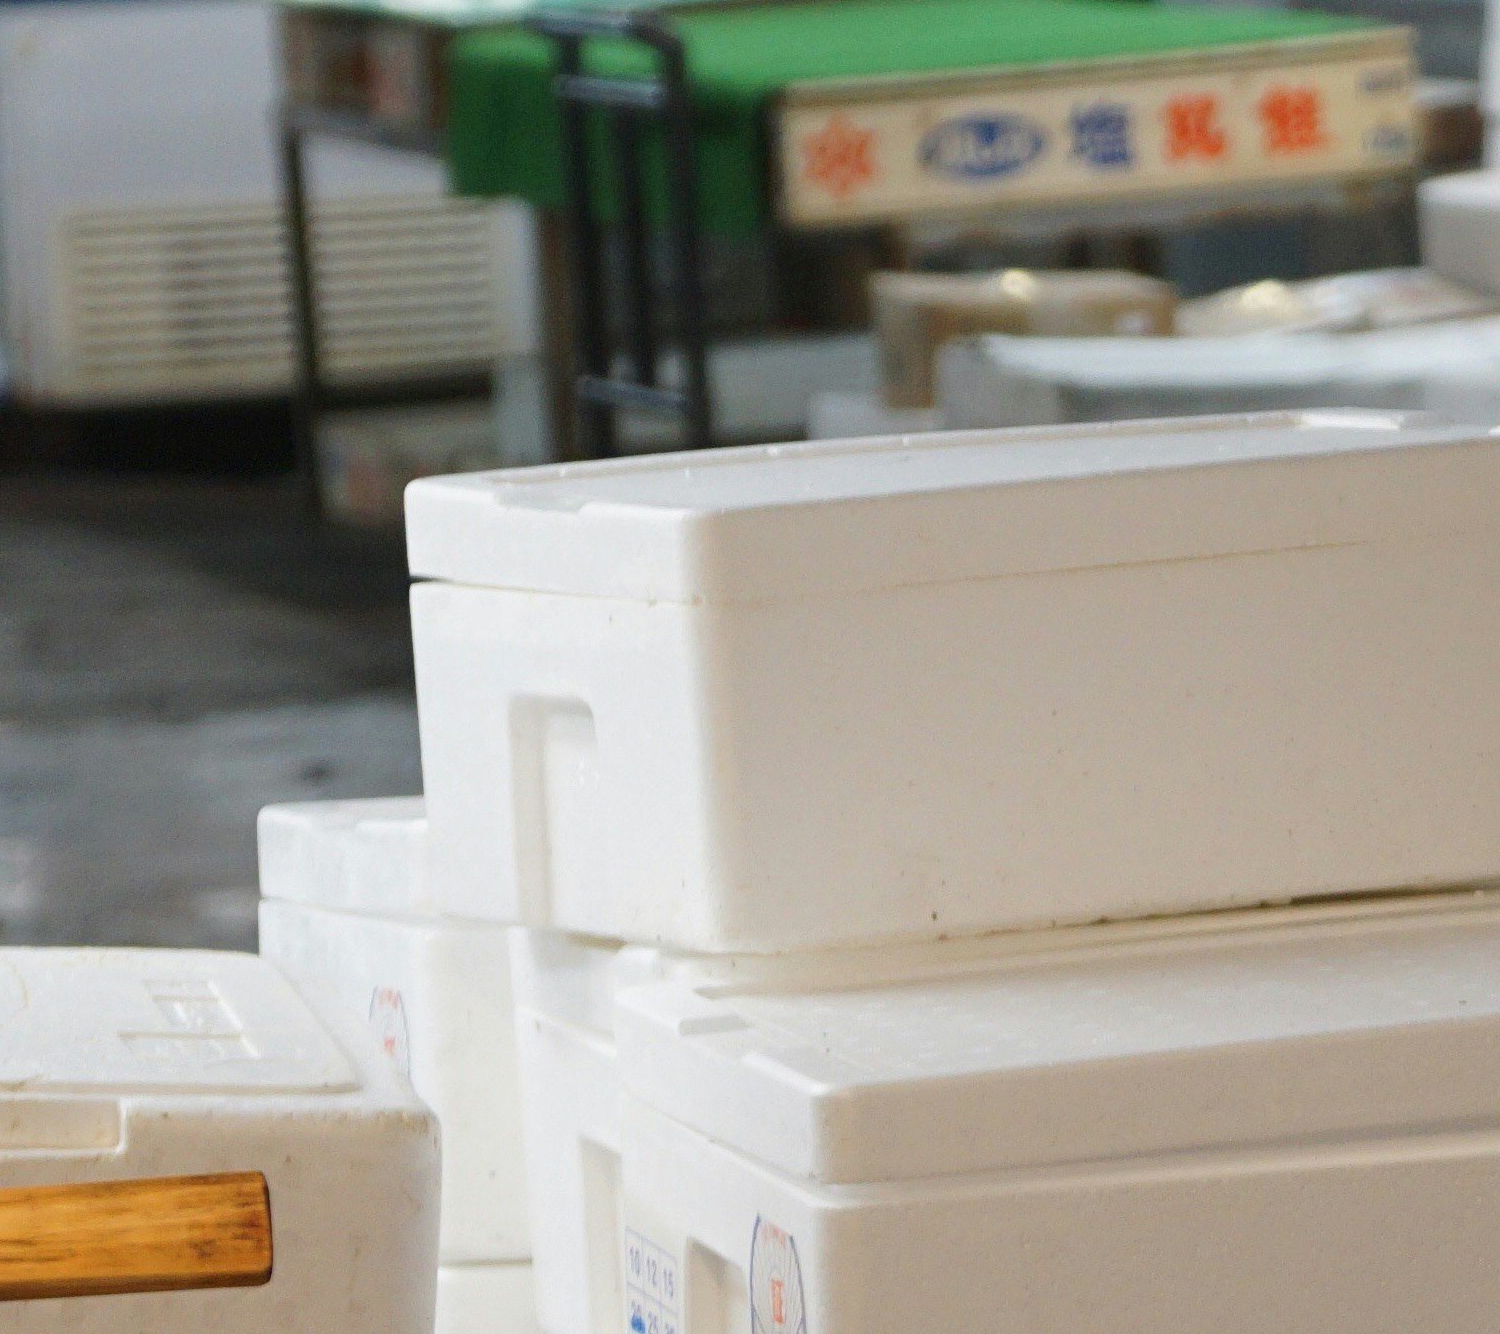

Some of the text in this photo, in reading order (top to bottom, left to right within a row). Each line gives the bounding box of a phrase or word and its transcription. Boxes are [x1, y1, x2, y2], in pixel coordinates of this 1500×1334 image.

[629, 1245, 675, 1299] 10 12 15
